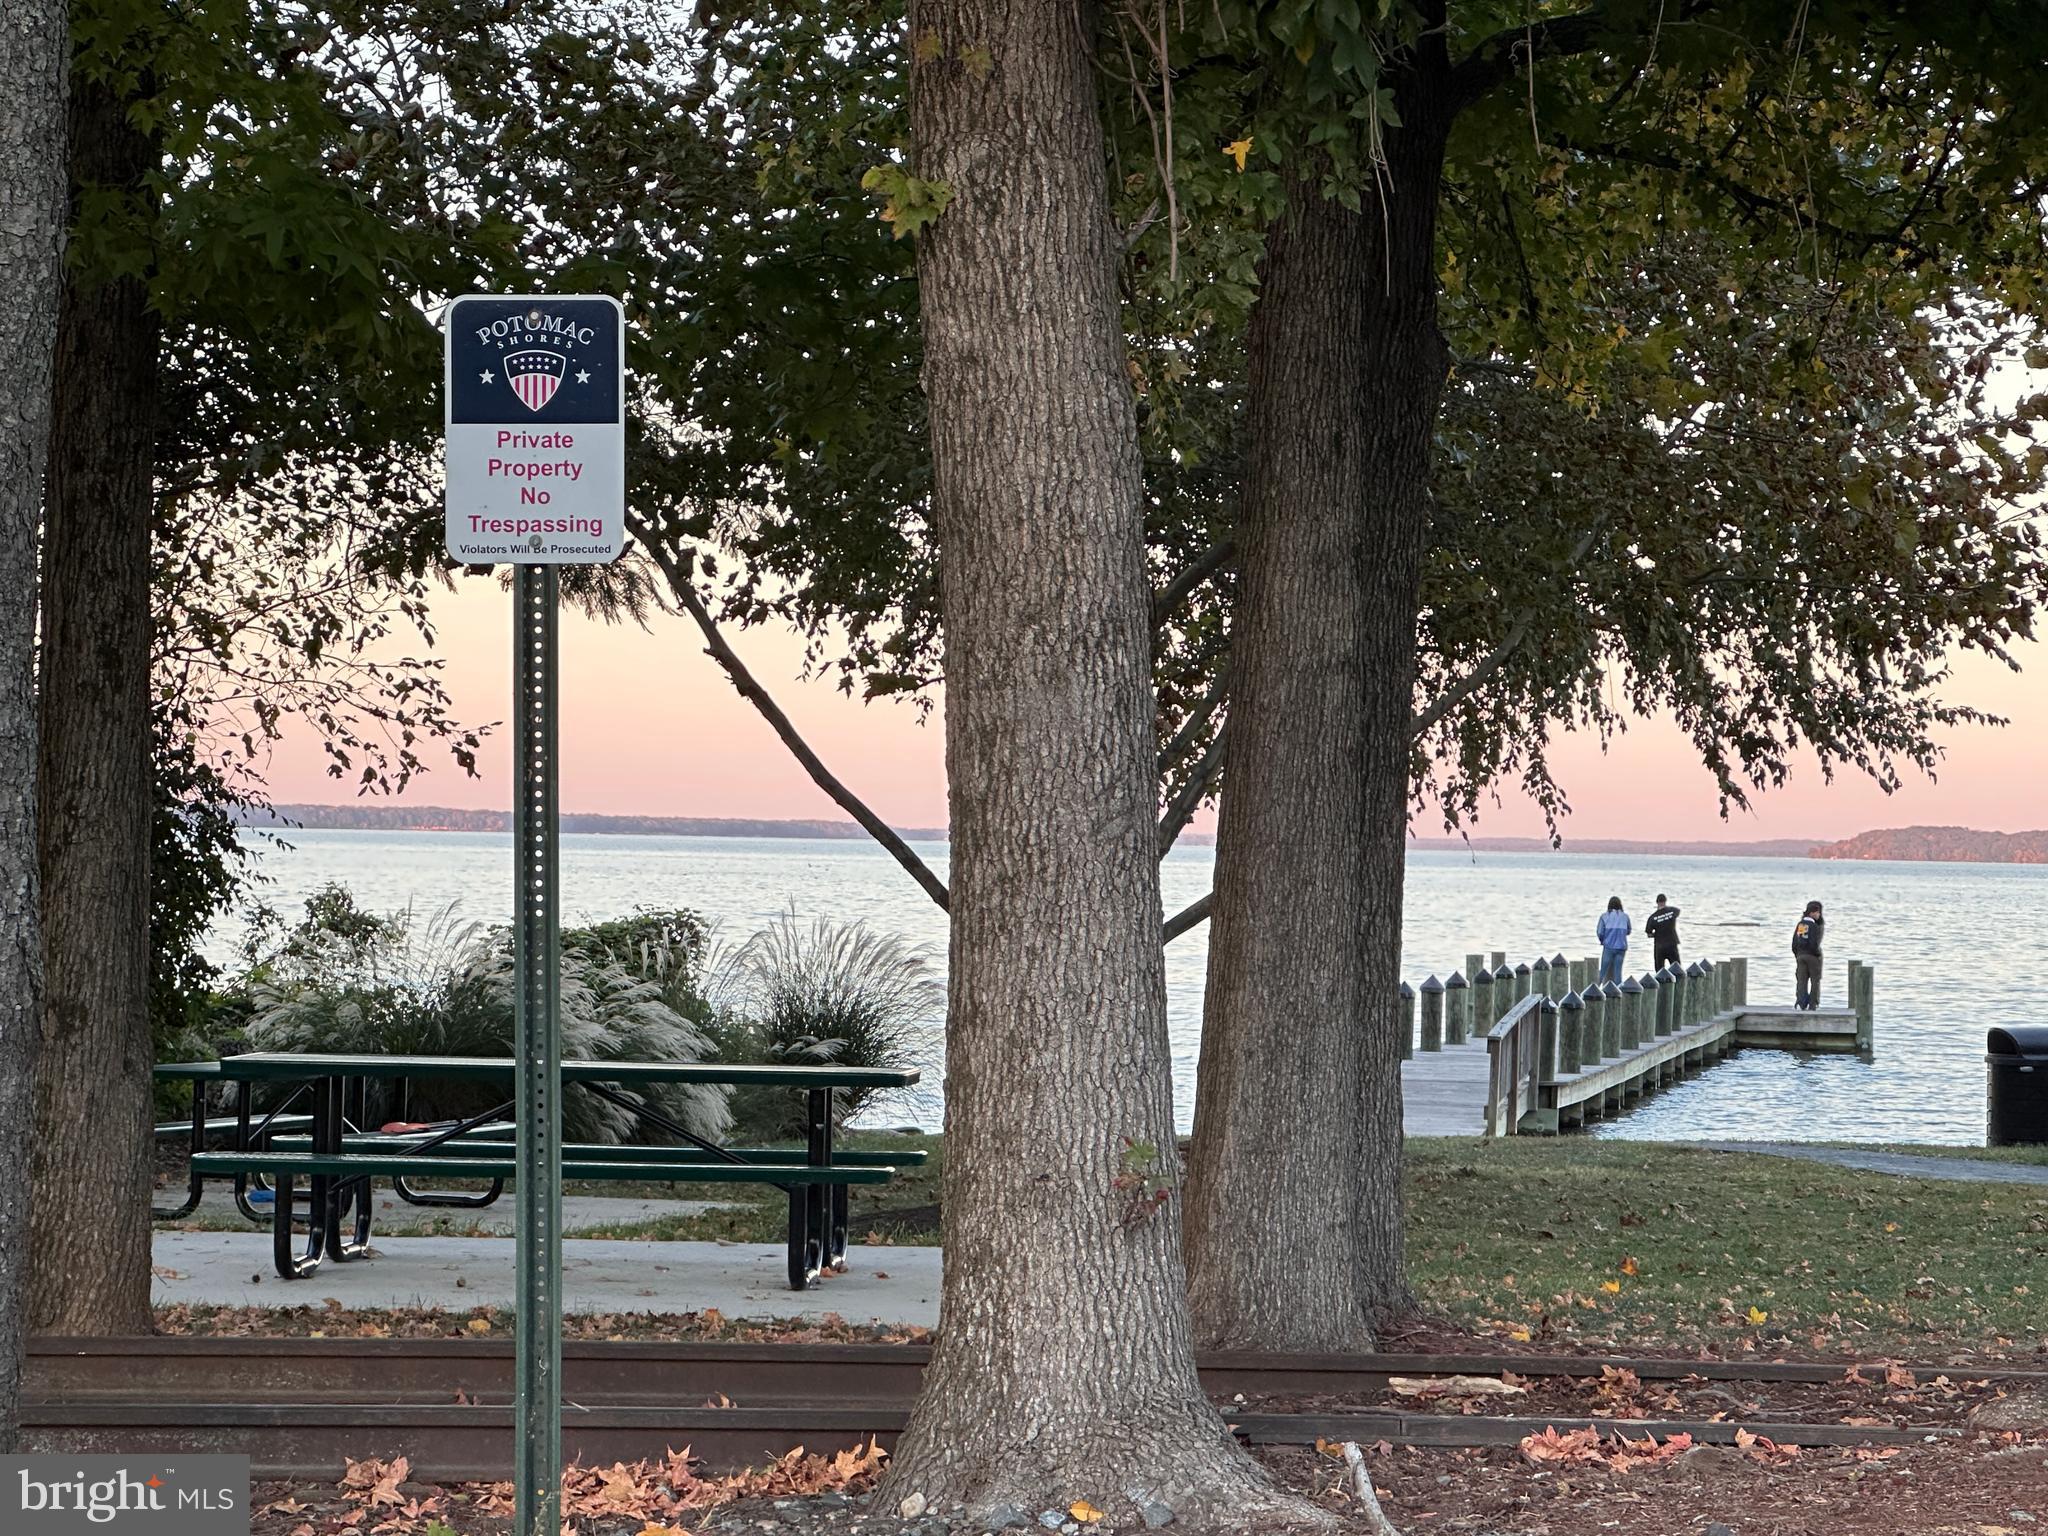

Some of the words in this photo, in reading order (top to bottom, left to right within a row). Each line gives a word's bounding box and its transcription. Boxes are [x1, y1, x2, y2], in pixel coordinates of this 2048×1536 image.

[475, 314, 595, 346] POTOMAC
[496, 334, 574, 350] SHORES
[497, 431, 574, 448] Private
[488, 459, 583, 480] Property
[521, 487, 551, 505] No
[468, 515, 603, 537] Trespassing
[460, 544, 507, 554] Violators
[510, 544, 531, 554] Will
[550, 544, 611, 554] Prosecuted
